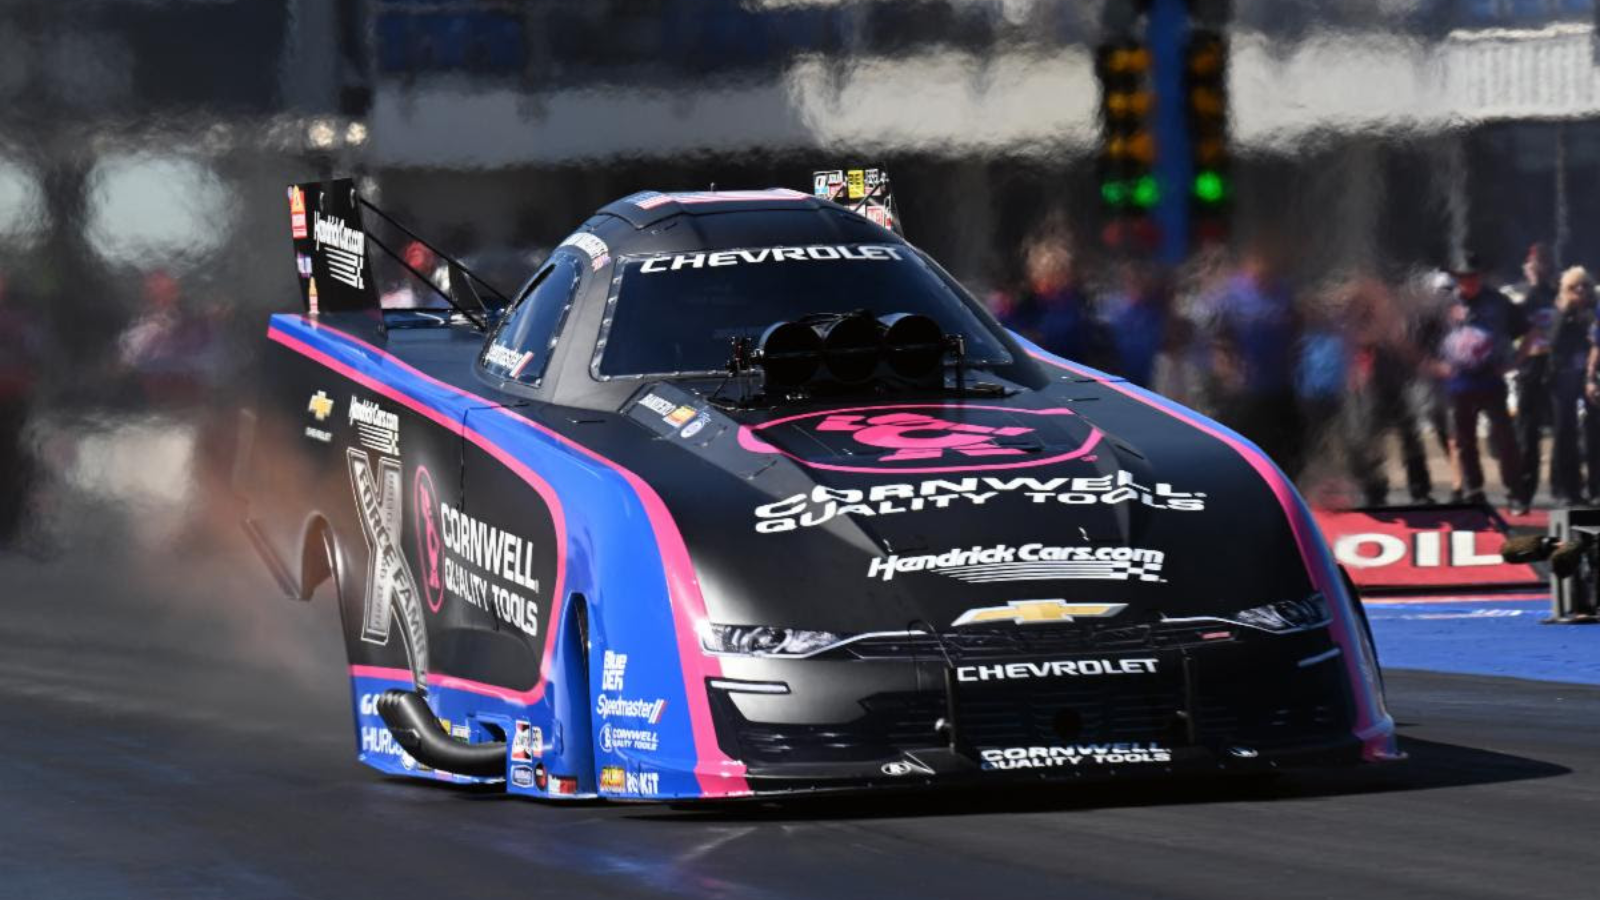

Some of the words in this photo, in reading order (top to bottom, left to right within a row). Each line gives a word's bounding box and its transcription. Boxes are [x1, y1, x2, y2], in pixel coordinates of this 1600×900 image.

[640, 246, 903, 273] CHEVROLET
[755, 470, 1195, 517] CORNWELL
[755, 491, 999, 533] QUALITY
[1024, 487, 1205, 511] TOOLS
[358, 468, 398, 567] FORCE
[441, 502, 539, 591] CORNWELL
[1333, 530, 1504, 568] OIL
[445, 557, 489, 612] QUALITY
[491, 583, 538, 637] TOOLS
[957, 658, 1159, 682] CHEVROLET
[981, 742, 1171, 762] CORNWELL
[981, 756, 1083, 770] QUALITY
[1094, 752, 1172, 764] TOOLS
